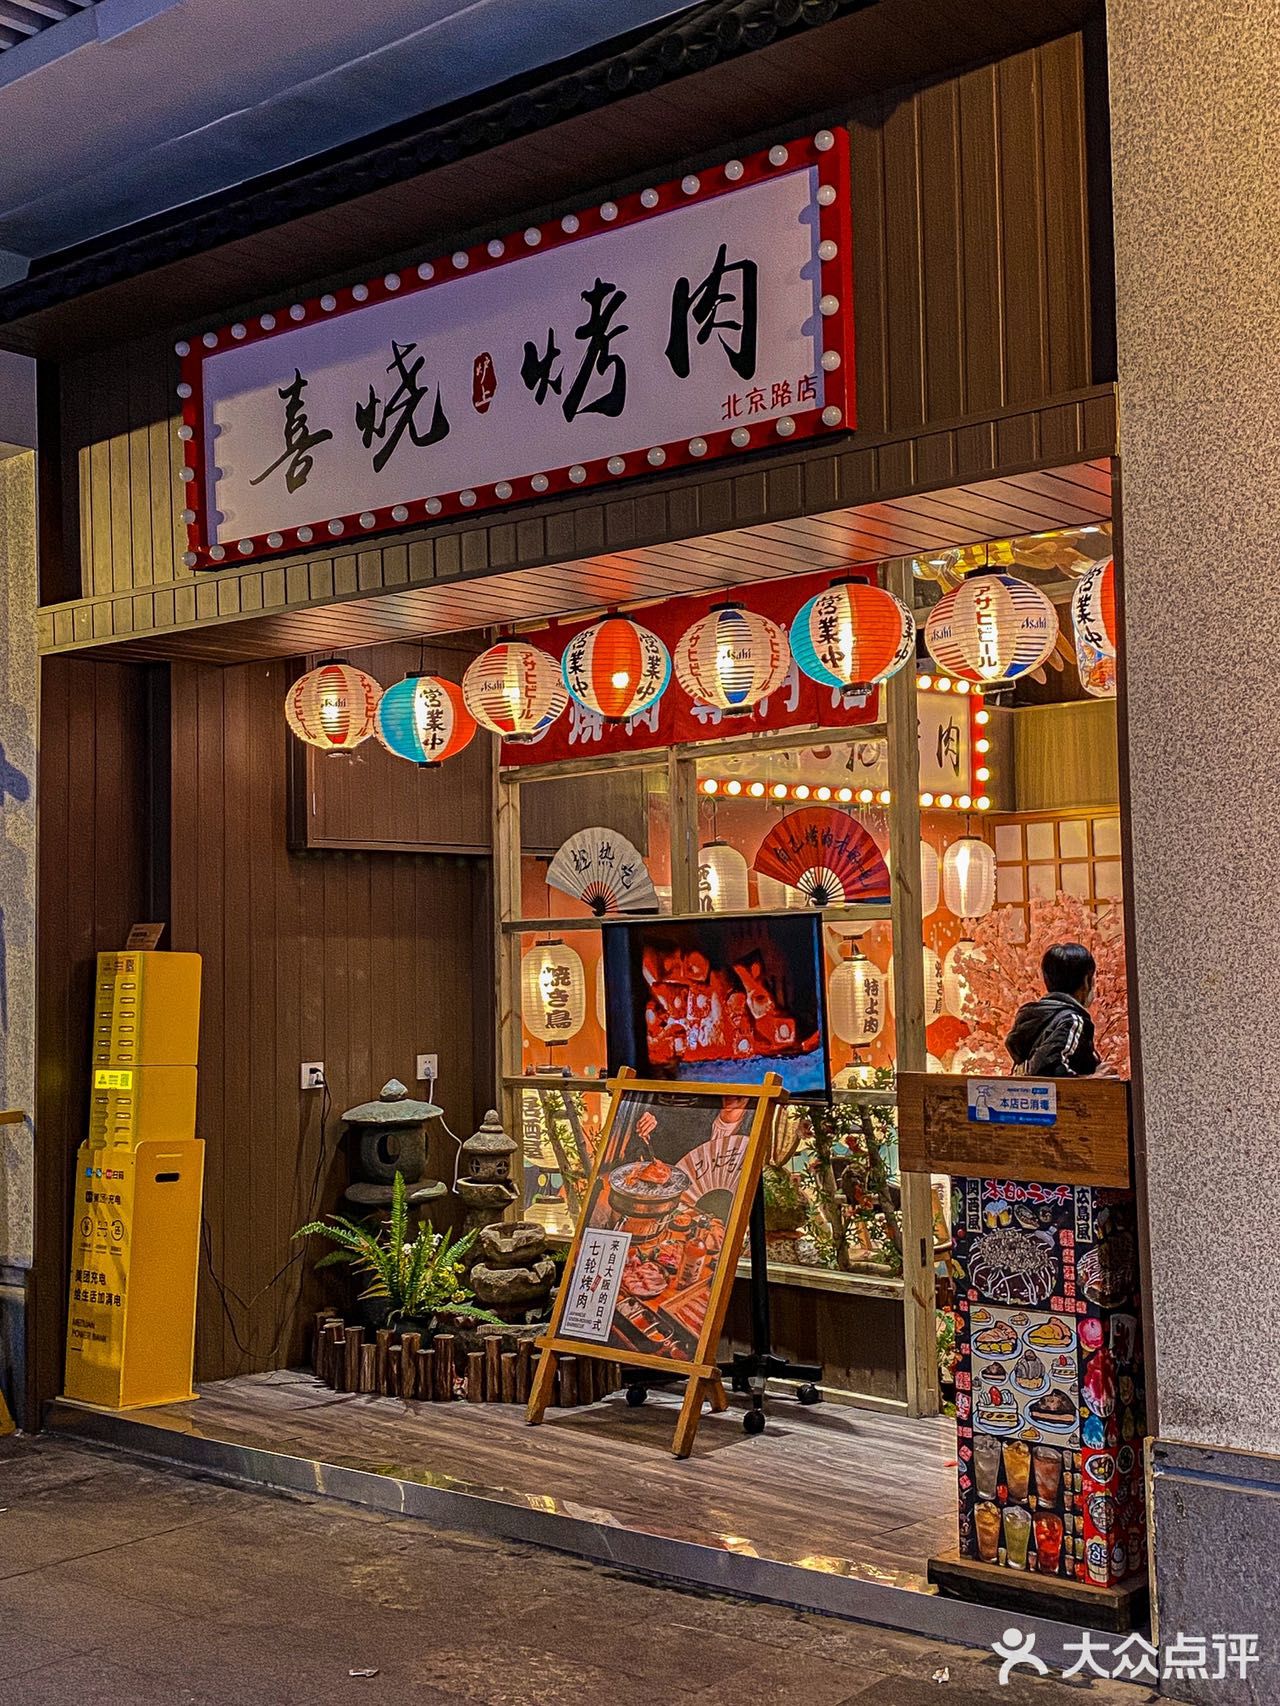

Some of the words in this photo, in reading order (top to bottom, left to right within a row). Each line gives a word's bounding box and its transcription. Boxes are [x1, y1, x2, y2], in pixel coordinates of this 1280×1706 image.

[721, 374, 818, 421] 北京路店
[930, 626, 953, 642] Asahi
[973, 585, 997, 668] アサヒビール
[1020, 616, 1047, 630] Asahi
[687, 623, 714, 698] アサヒビール
[755, 618, 780, 692] アサヒビール
[480, 679, 505, 692] Asahi
[518, 651, 537, 720] アサヒビール
[543, 965, 573, 1029] 焼き鳥
[863, 977, 881, 1034] 特上肉
[999, 1097, 1050, 1111] 本店已消毒
[982, 1178, 1074, 1208] 本日のランチ
[75, 1269, 107, 1286] 美团充电
[576, 1240, 601, 1310] 七轮烤肉
[591, 1240, 620, 1332] 来自大阪的日式
